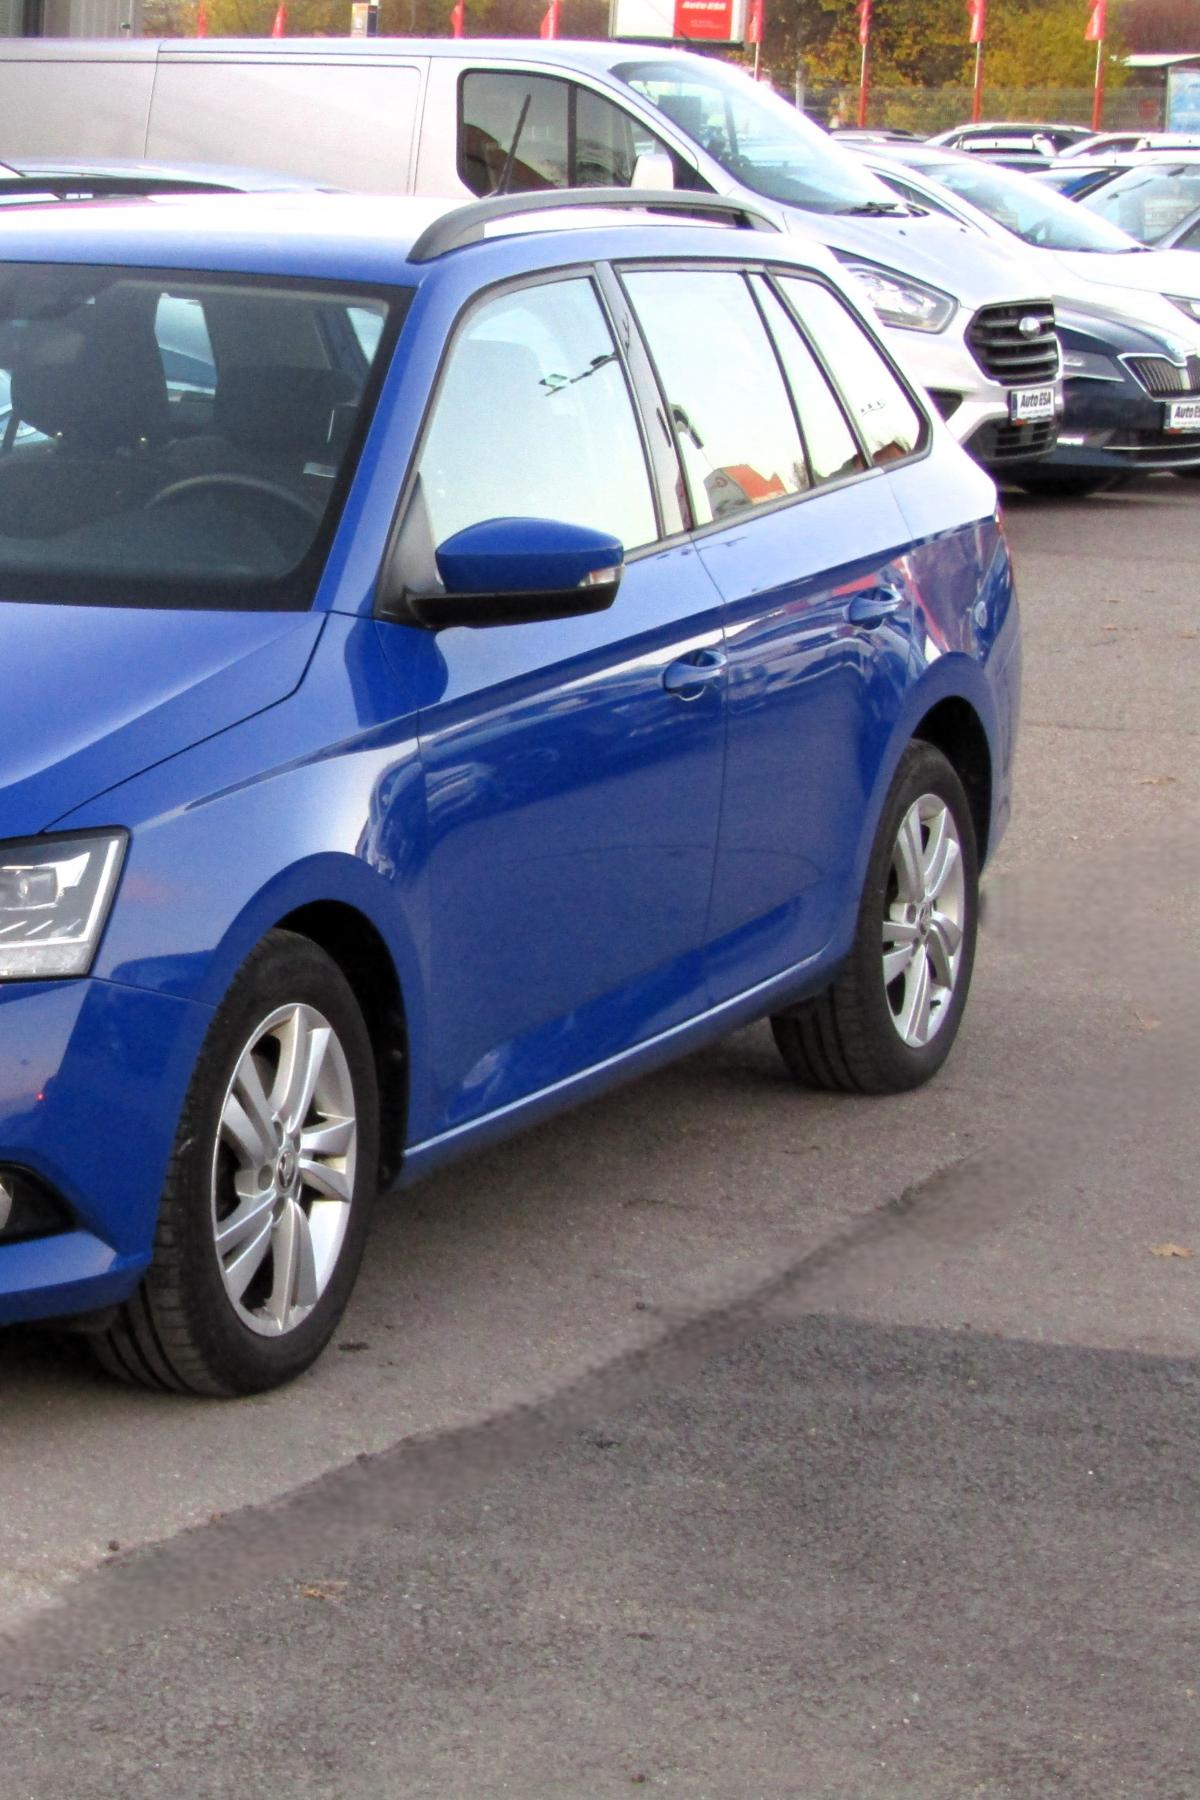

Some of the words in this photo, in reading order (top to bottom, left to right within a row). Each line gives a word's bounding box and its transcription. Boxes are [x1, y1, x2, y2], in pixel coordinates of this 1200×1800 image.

[1020, 394, 1039, 409] Auto
[1039, 391, 1052, 406] ESA
[1174, 406, 1193, 418] Auto
